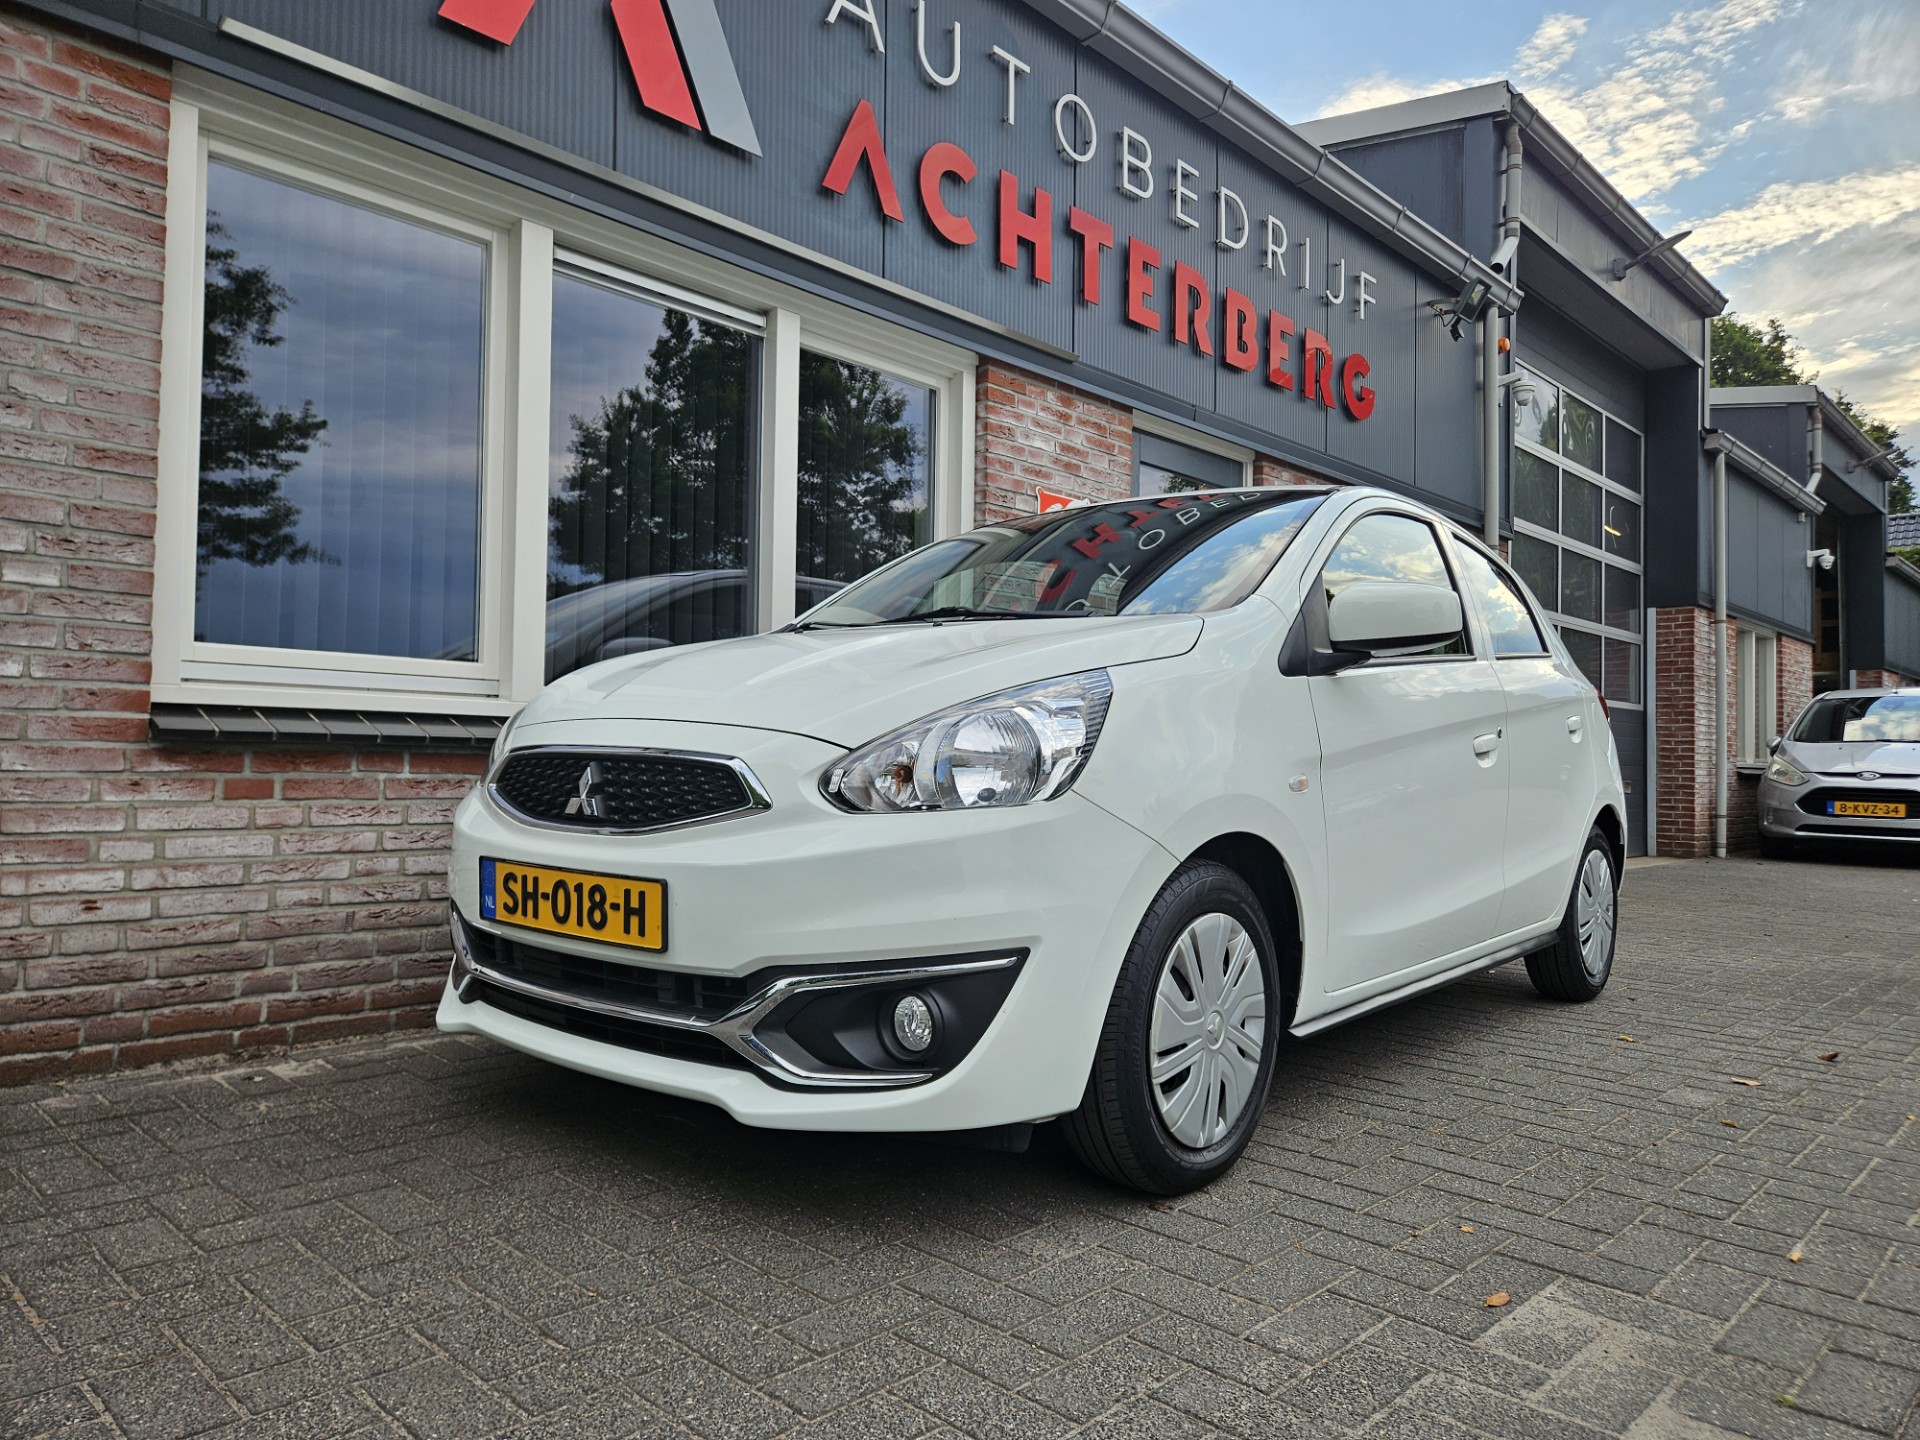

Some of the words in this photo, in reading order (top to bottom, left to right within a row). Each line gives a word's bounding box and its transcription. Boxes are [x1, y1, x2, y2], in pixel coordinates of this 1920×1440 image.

[825, 0, 1377, 320] AUTOBEDRIJF
[821, 98, 1376, 421] ACHTERBERG
[1839, 803, 1900, 815] 8-KVZ-34
[485, 894, 495, 909] NL
[502, 871, 646, 938] SH-018-H
